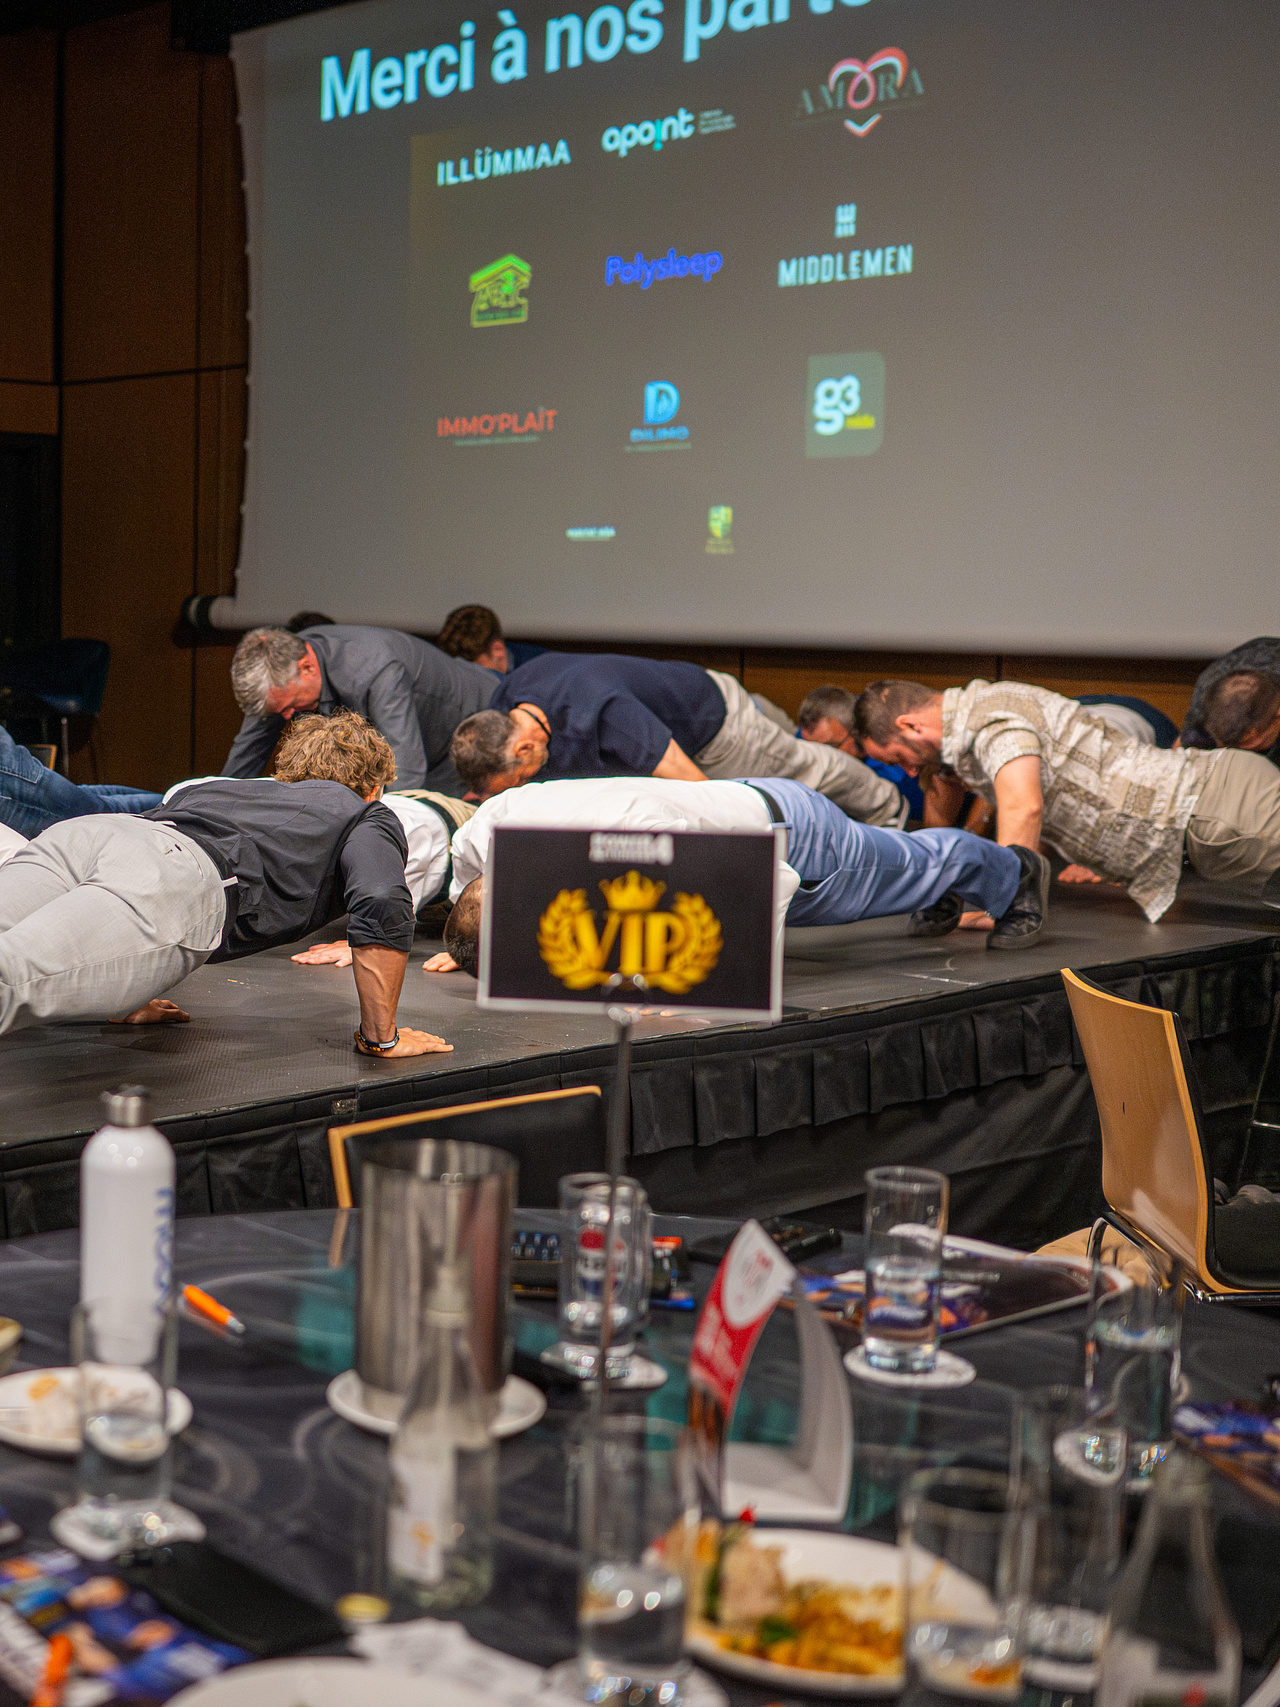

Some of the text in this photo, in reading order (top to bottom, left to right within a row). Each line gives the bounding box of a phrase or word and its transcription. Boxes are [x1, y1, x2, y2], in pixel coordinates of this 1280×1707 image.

[320, 20, 476, 122] Merci
[490, 9, 528, 84] à
[544, 0, 664, 74] nos
[436, 138, 572, 187] ILLÜMMAA
[604, 248, 724, 290] Polysleep
[777, 243, 914, 288] MIDDLEMEN
[573, 910, 688, 976] VIP
